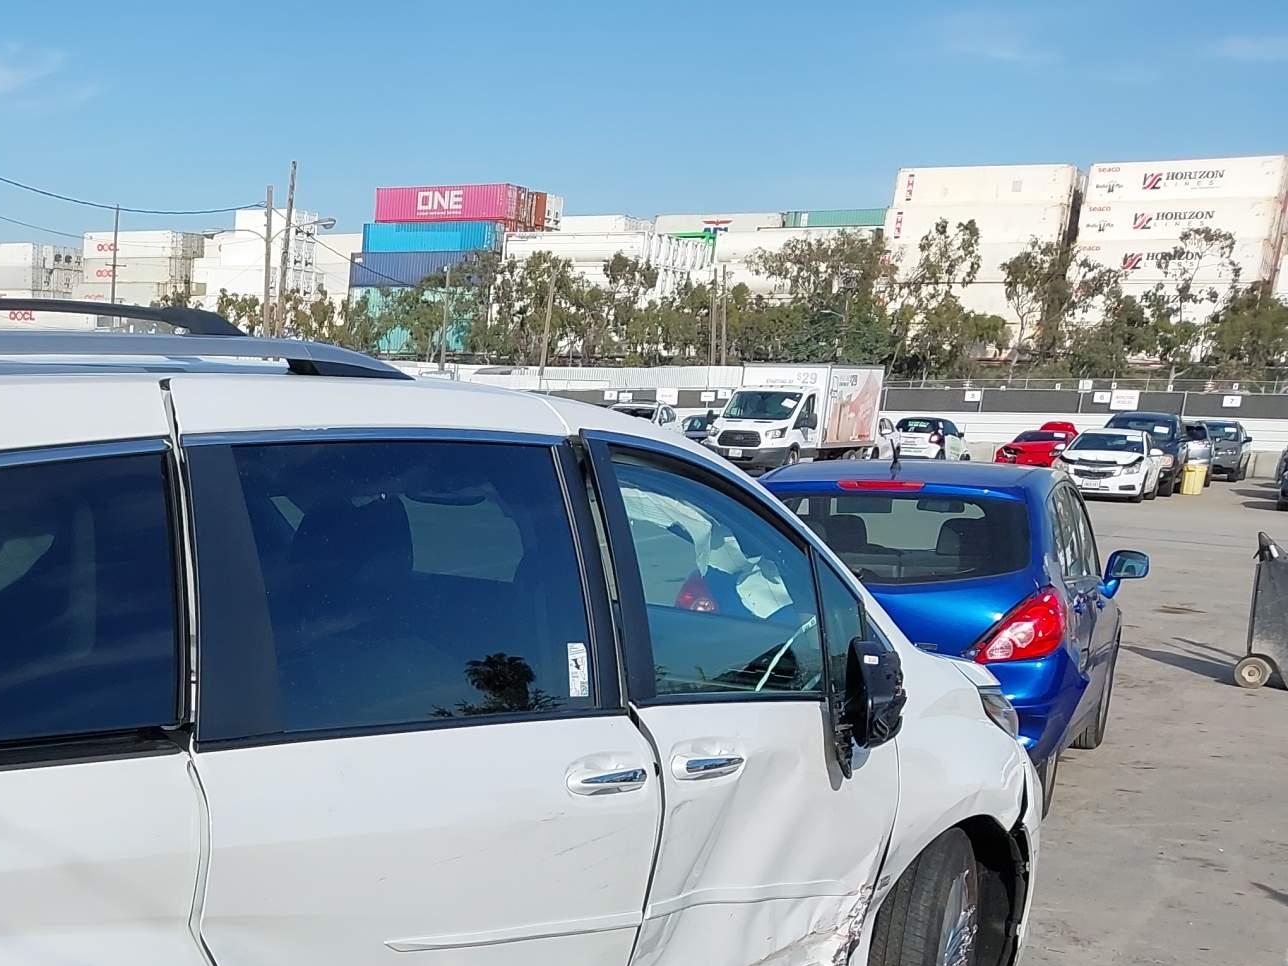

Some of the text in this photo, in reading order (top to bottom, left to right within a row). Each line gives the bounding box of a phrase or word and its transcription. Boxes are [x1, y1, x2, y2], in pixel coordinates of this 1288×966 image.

[1166, 170, 1225, 181] HORIZON
[417, 190, 463, 210] ONE
[1156, 210, 1215, 221] HORIZON
[9, 311, 35, 321] OOCL
[797, 372, 818, 385] $29
